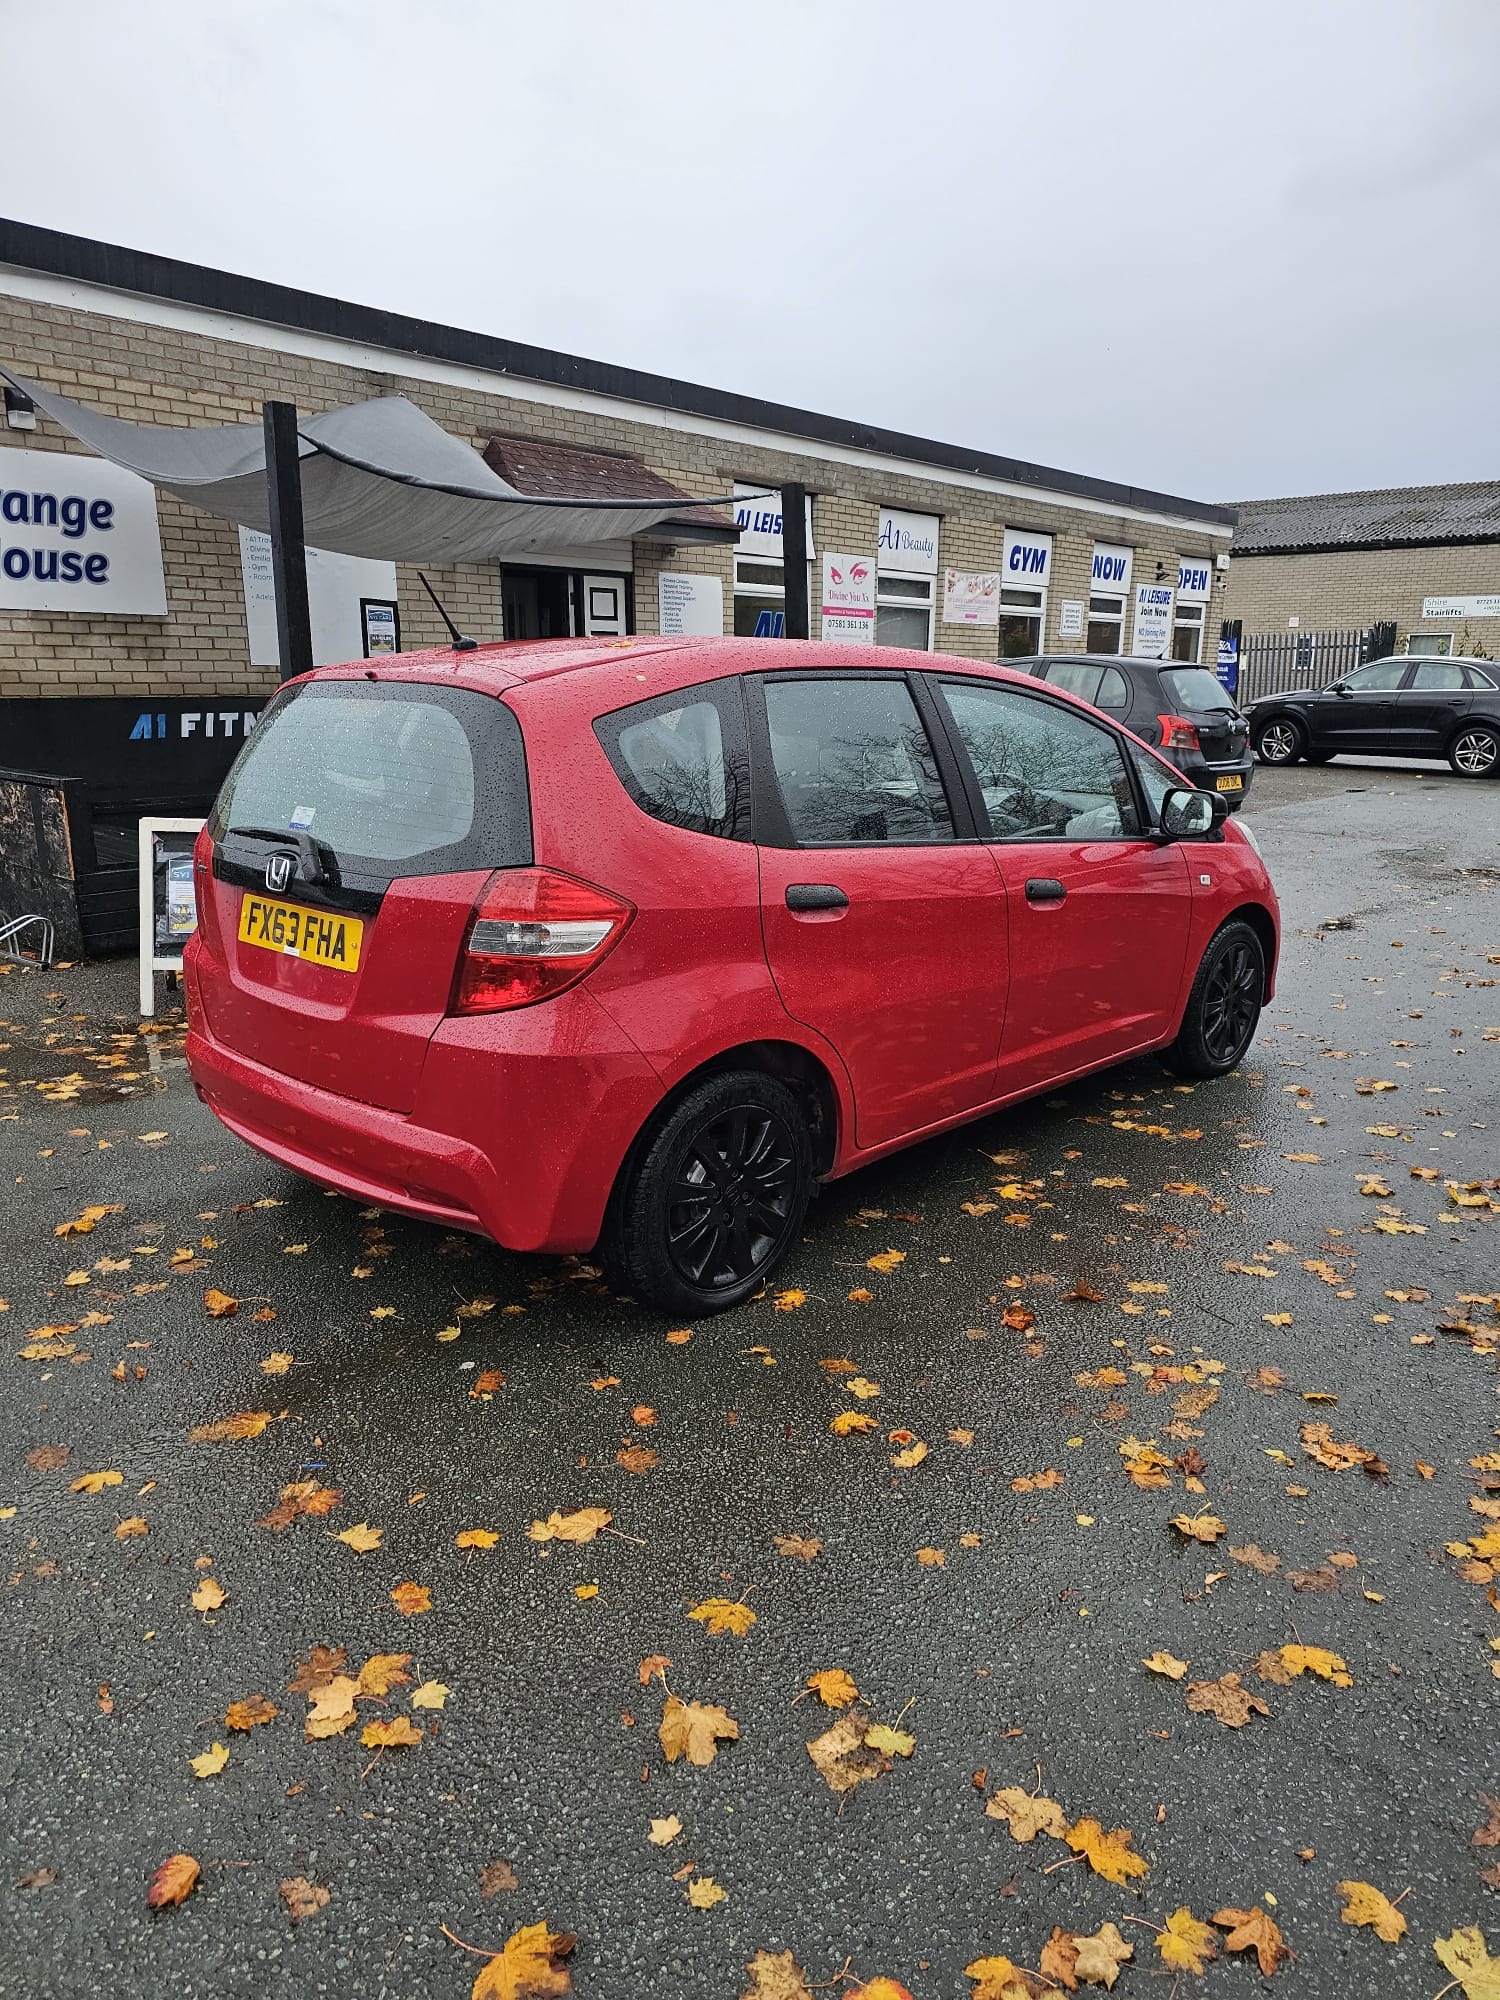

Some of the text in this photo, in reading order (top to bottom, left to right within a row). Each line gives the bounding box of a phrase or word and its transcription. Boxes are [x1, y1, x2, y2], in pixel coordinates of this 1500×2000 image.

[0, 489, 115, 539] ange
[753, 511, 784, 535] LEIS
[901, 530, 933, 559] Beauty
[0, 547, 110, 585] ouse
[1009, 544, 1047, 574] GYM
[1092, 555, 1127, 582] NOW
[1140, 606, 1168, 617] Join Now
[1147, 590, 1172, 605] LEISURE
[1426, 609, 1462, 617] Stairlifts
[247, 901, 346, 963] FX63 FHA
